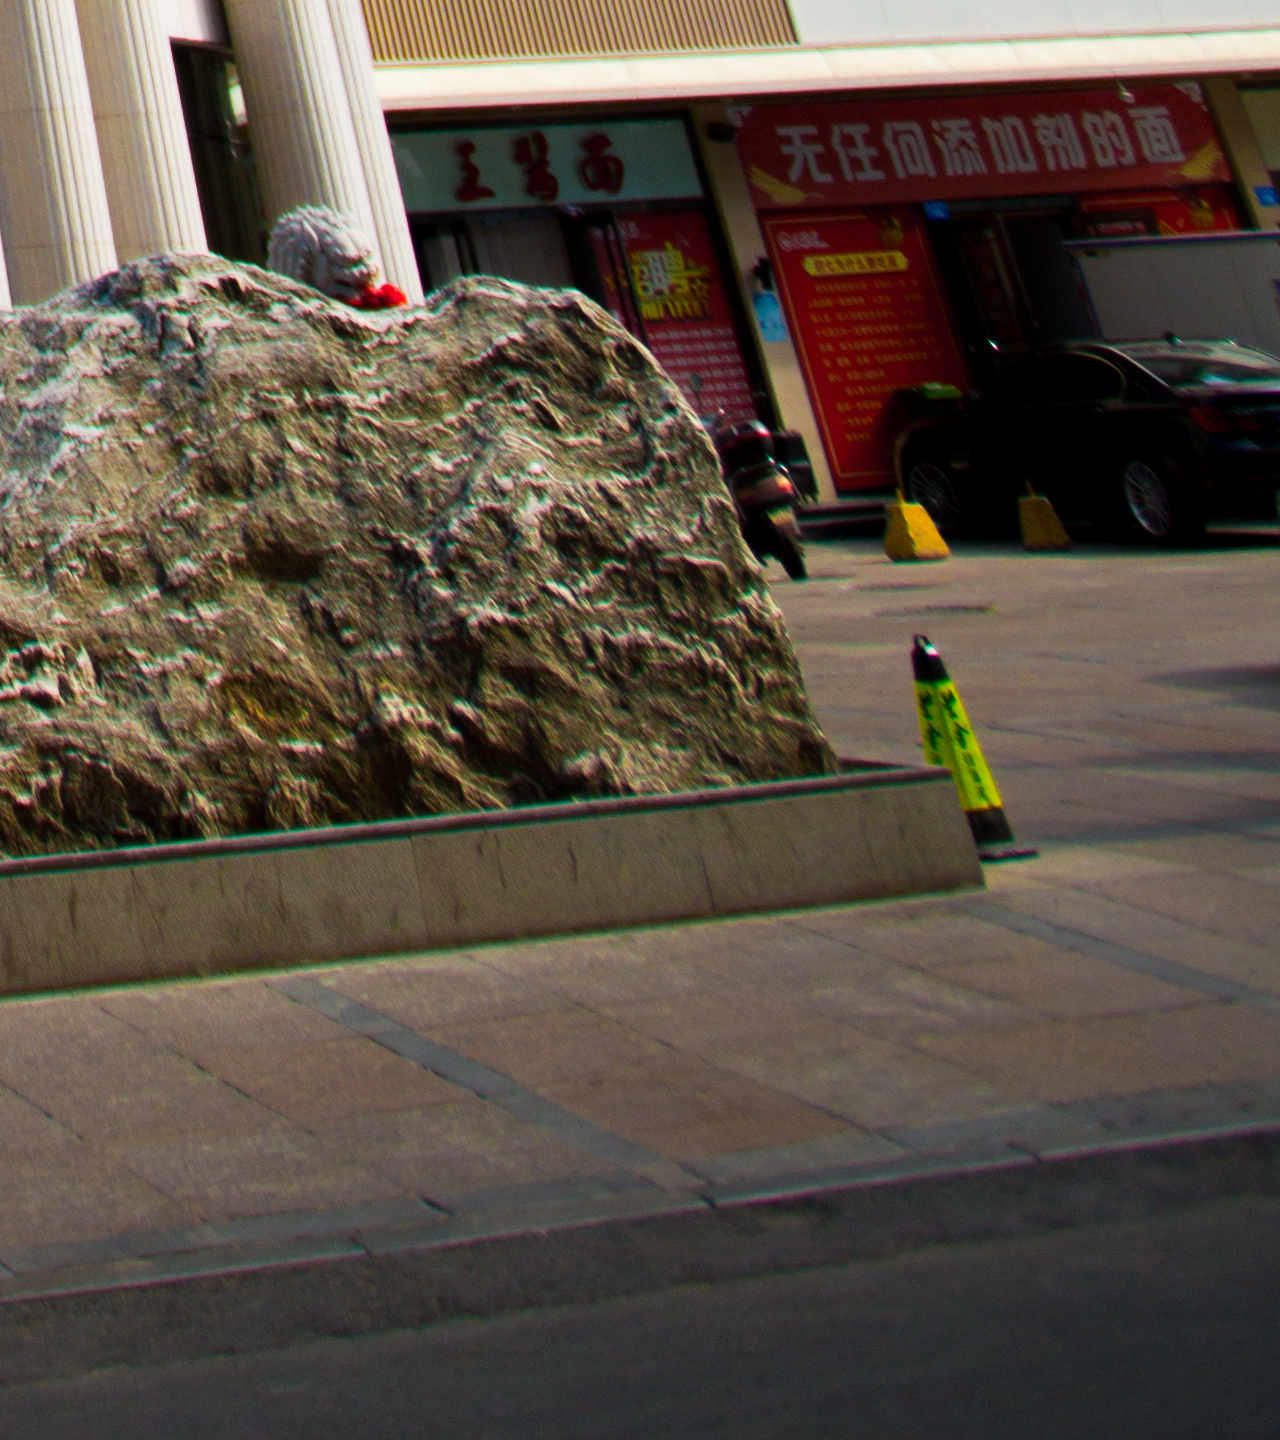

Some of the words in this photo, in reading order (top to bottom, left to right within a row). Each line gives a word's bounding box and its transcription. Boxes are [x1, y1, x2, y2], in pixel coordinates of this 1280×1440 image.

[775, 106, 1186, 182] 无任何添加剂的面
